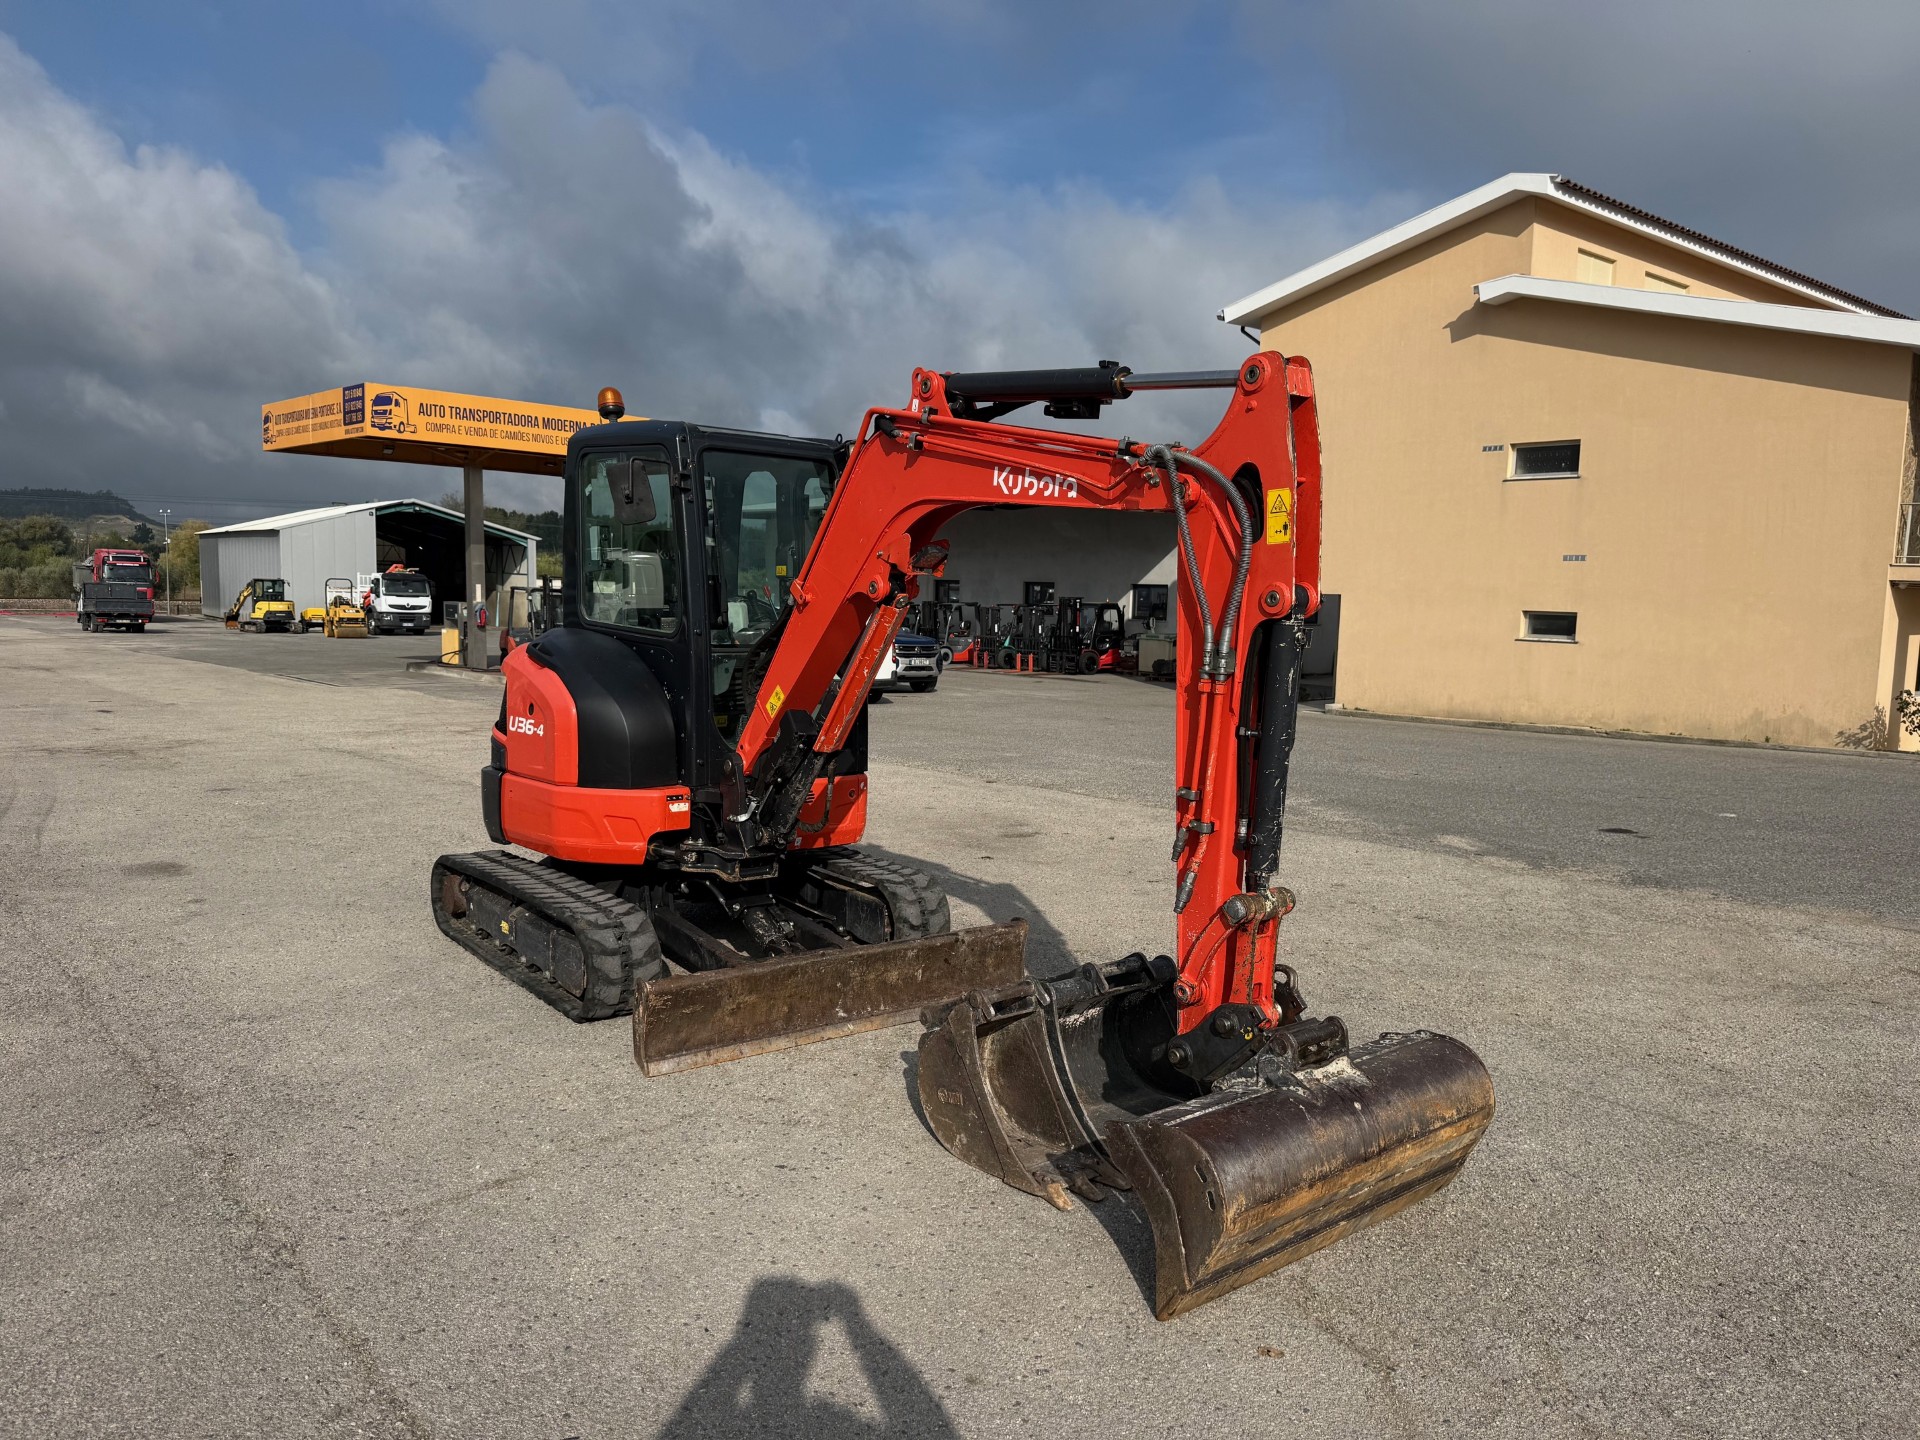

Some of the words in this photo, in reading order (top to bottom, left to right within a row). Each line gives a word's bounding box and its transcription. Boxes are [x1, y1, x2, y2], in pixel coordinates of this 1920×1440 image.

[418, 402, 446, 418] AUTO
[448, 406, 540, 429] TRANSPORTADORA
[425, 422, 456, 434] COMPRA
[458, 425, 463, 435] E
[464, 426, 488, 438] VENDA
[490, 428, 499, 439] DE
[532, 433, 554, 445] NOVOS
[556, 436, 560, 446] E
[993, 466, 1078, 498] Kubota
[509, 716, 544, 737] U36-4
